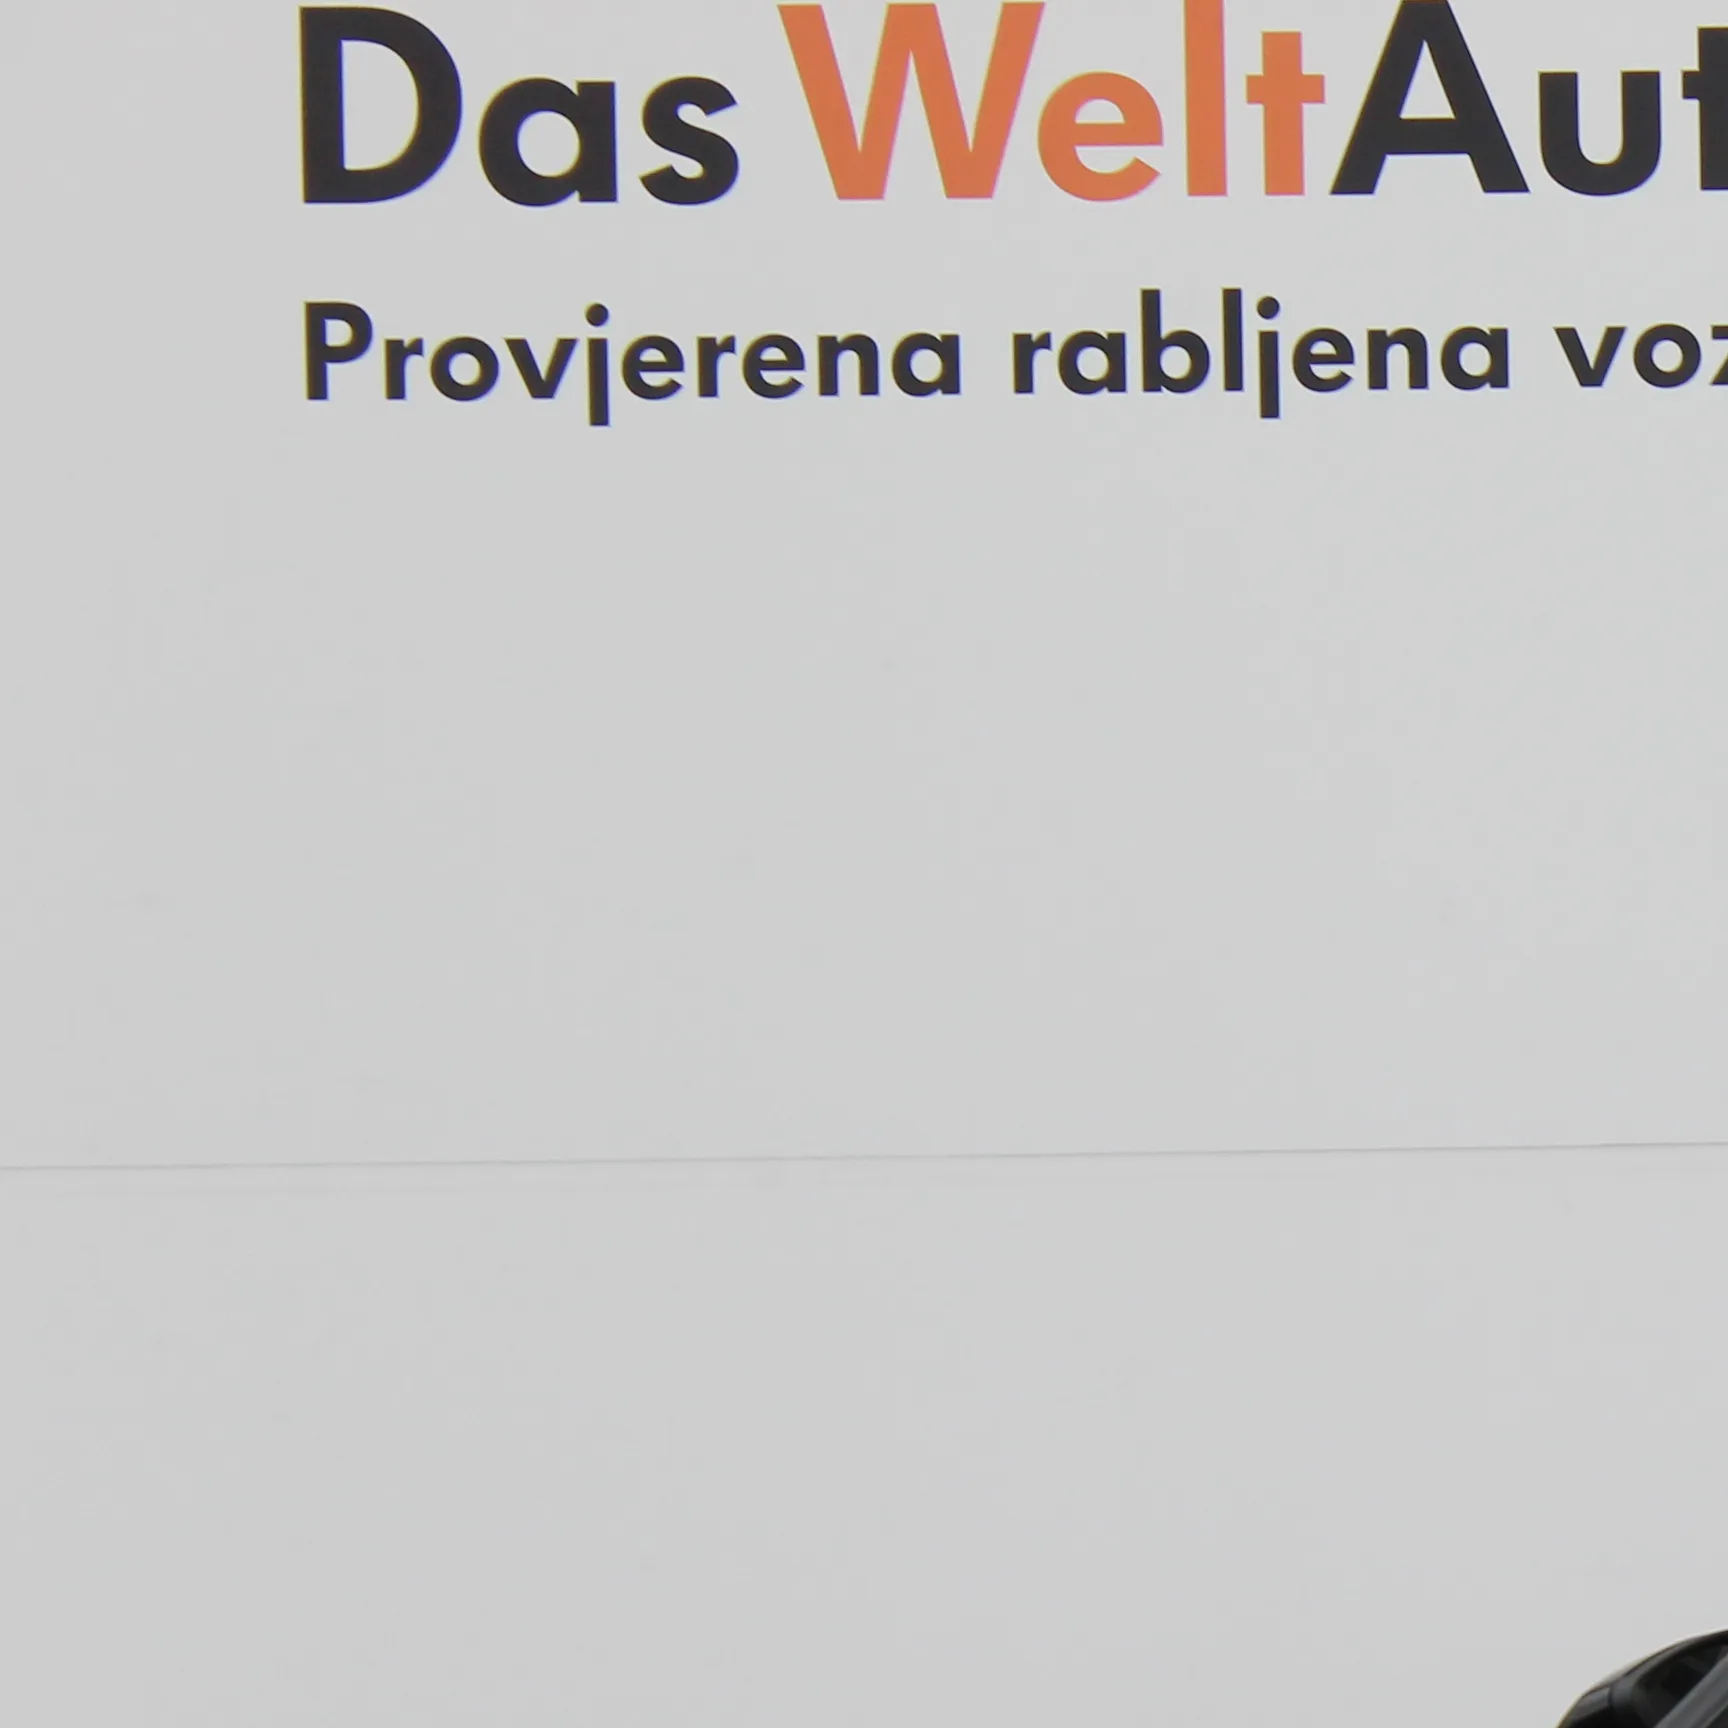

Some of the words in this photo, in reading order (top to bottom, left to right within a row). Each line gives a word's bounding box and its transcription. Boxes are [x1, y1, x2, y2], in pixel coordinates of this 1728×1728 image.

[299, 6, 738, 207] Das
[305, 302, 960, 426] Provjerena
[1013, 288, 1508, 418] rabljena
